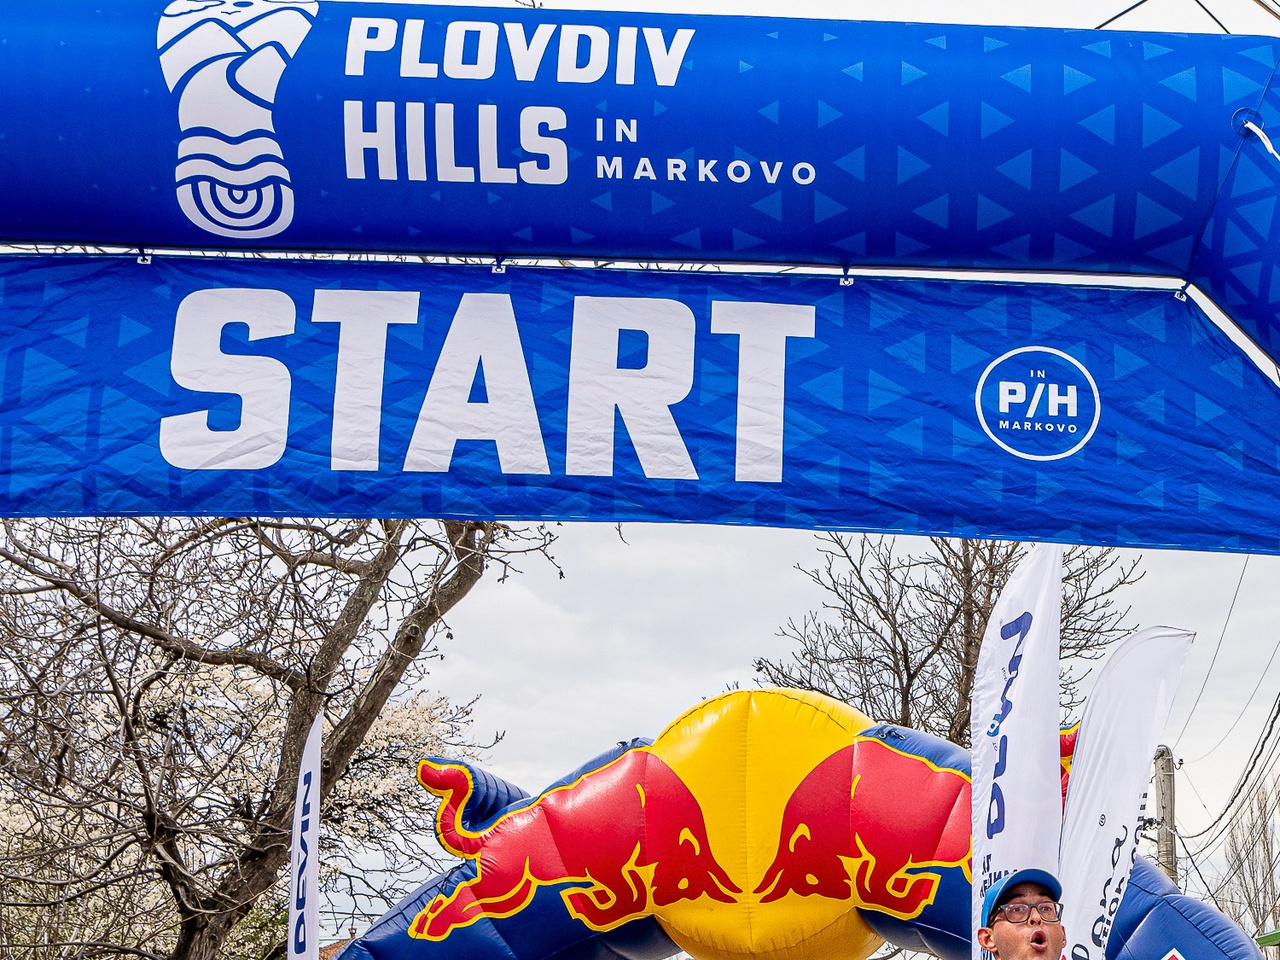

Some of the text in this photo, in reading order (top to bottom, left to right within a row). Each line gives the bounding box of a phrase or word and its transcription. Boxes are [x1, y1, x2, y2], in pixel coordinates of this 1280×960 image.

[344, 17, 695, 86] PLOVDIV
[344, 101, 568, 186] HILLS
[596, 118, 638, 143] IN
[596, 156, 817, 185] MARKOVO
[160, 288, 816, 483] START
[1030, 369, 1045, 378] IN
[998, 381, 1078, 418] P/H
[999, 420, 1077, 434] MARKOVO
